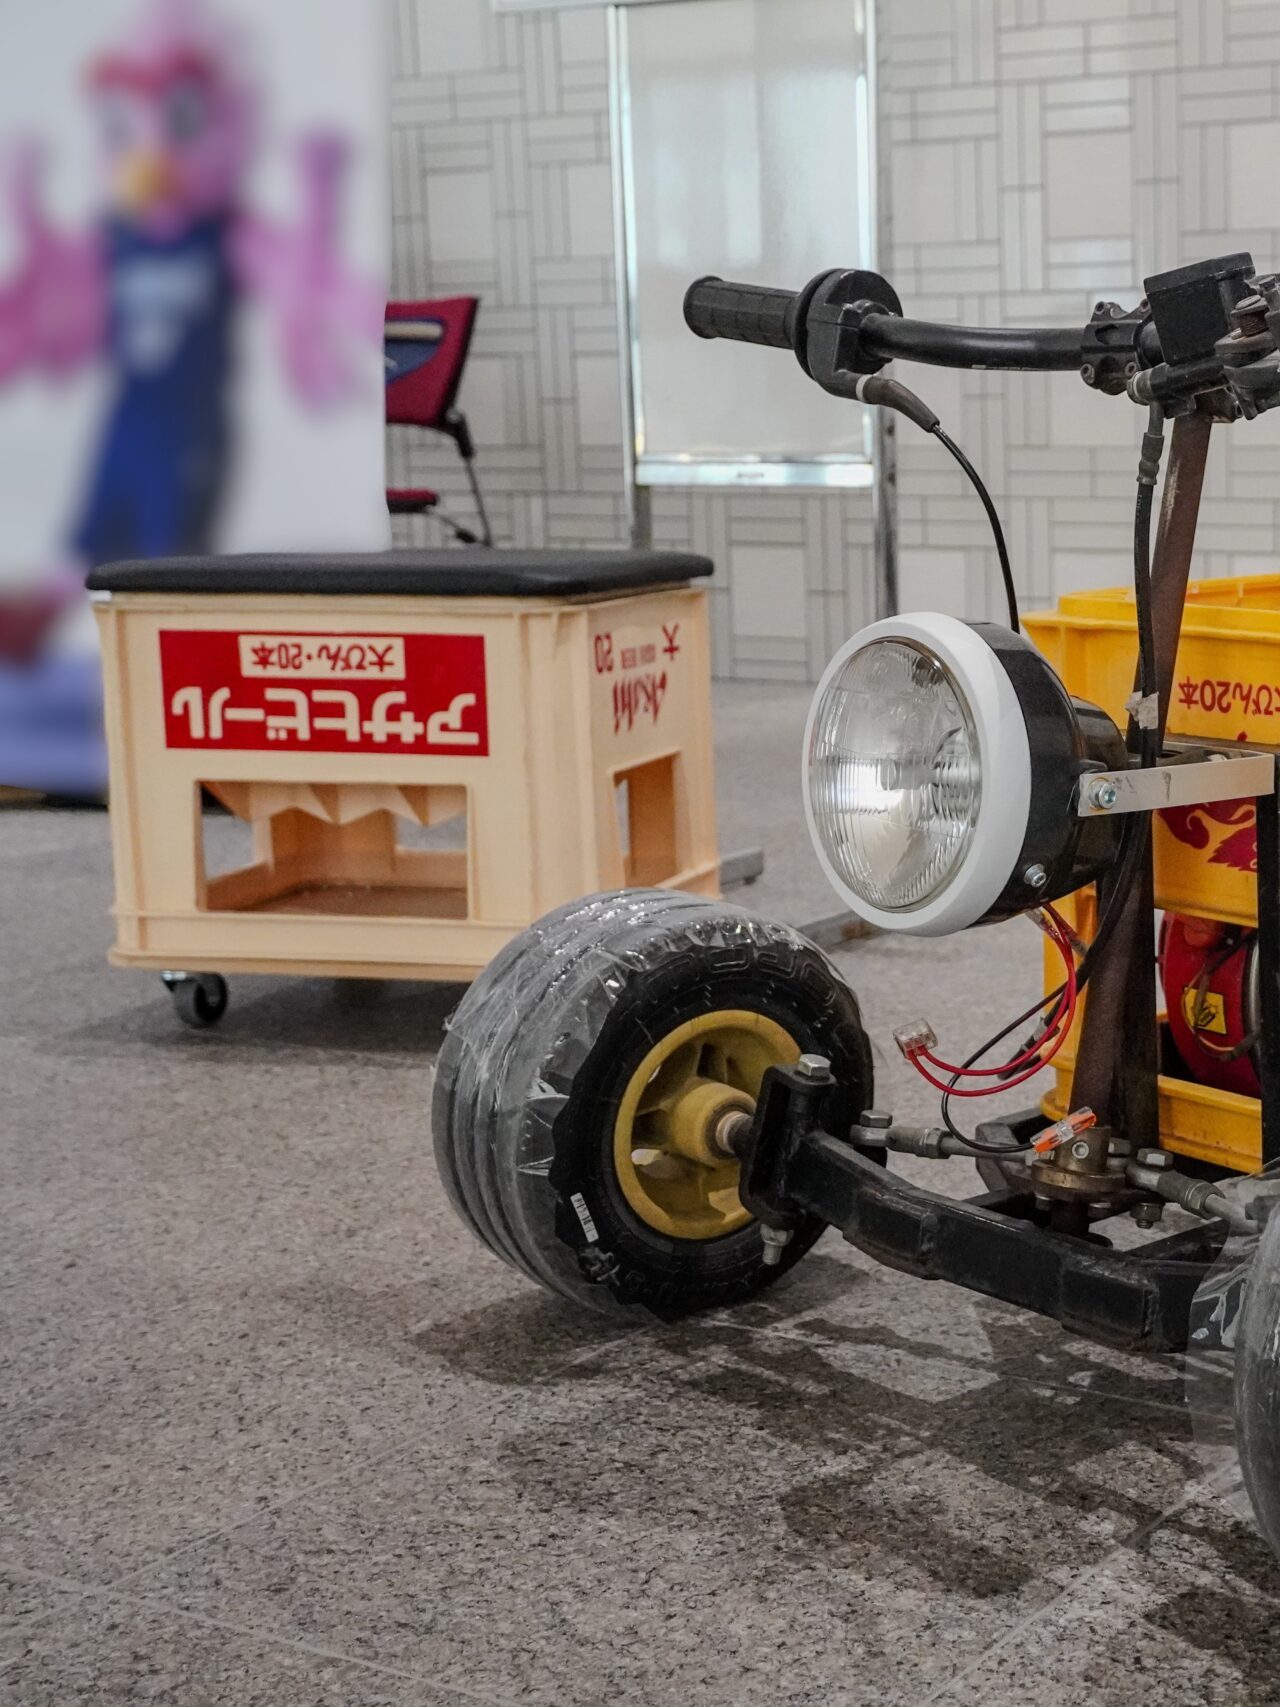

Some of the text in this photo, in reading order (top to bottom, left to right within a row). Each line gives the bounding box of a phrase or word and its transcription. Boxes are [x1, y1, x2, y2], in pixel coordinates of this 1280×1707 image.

[594, 632, 613, 674] 20
[171, 686, 480, 746] アサヒビール
[613, 670, 668, 735] Asahi
